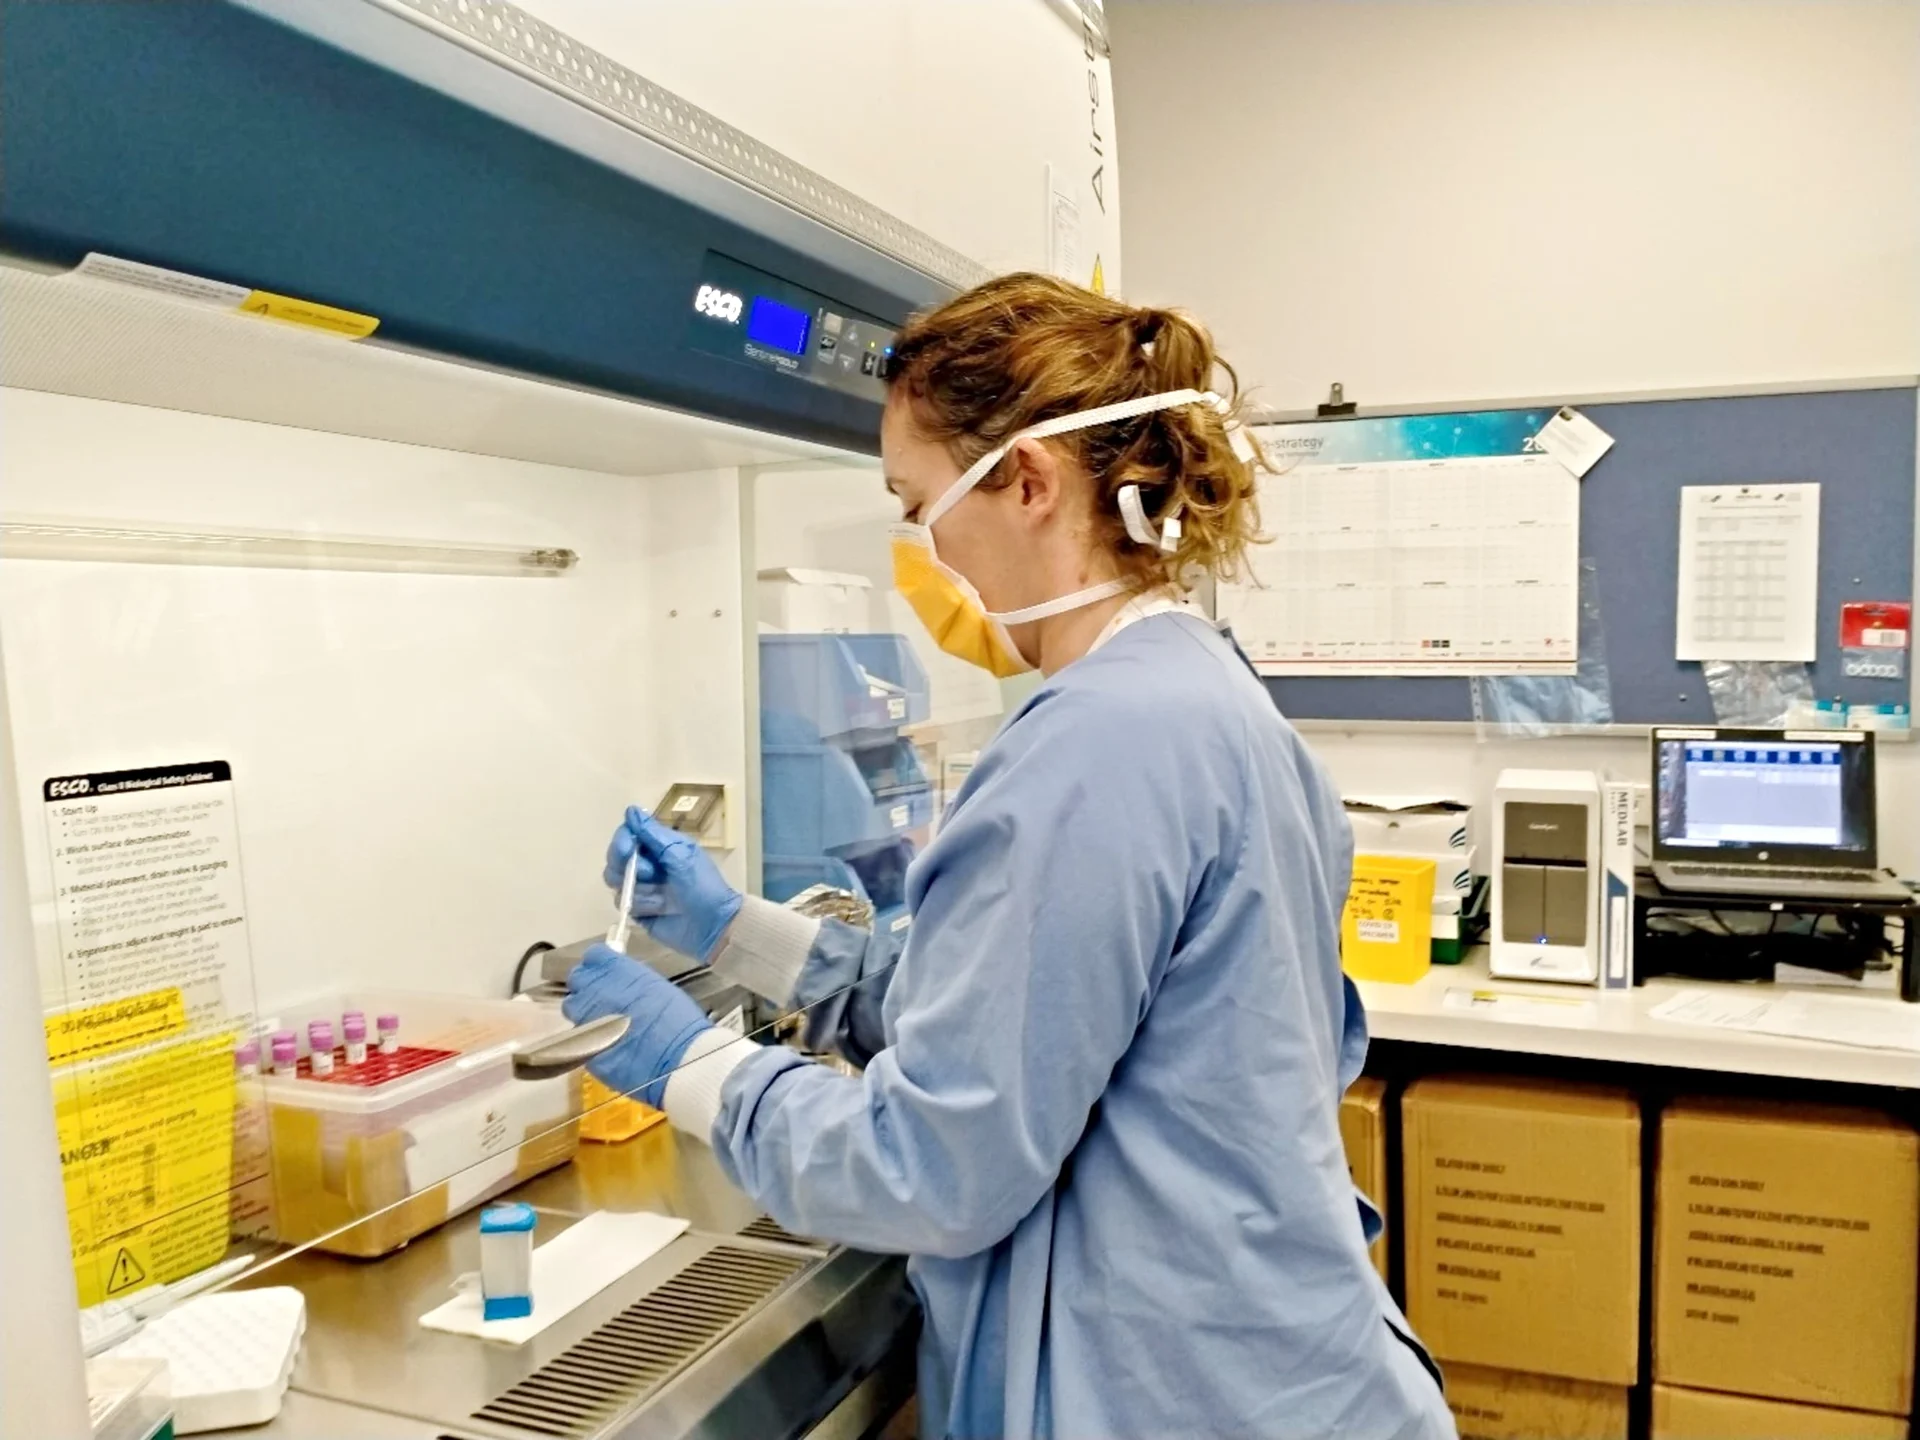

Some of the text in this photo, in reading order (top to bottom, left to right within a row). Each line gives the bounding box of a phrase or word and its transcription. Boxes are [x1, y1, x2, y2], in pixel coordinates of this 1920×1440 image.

[49, 778, 91, 798] ESCO
[1616, 791, 1629, 847] MEDLAB
[59, 1138, 112, 1167] ANGER
